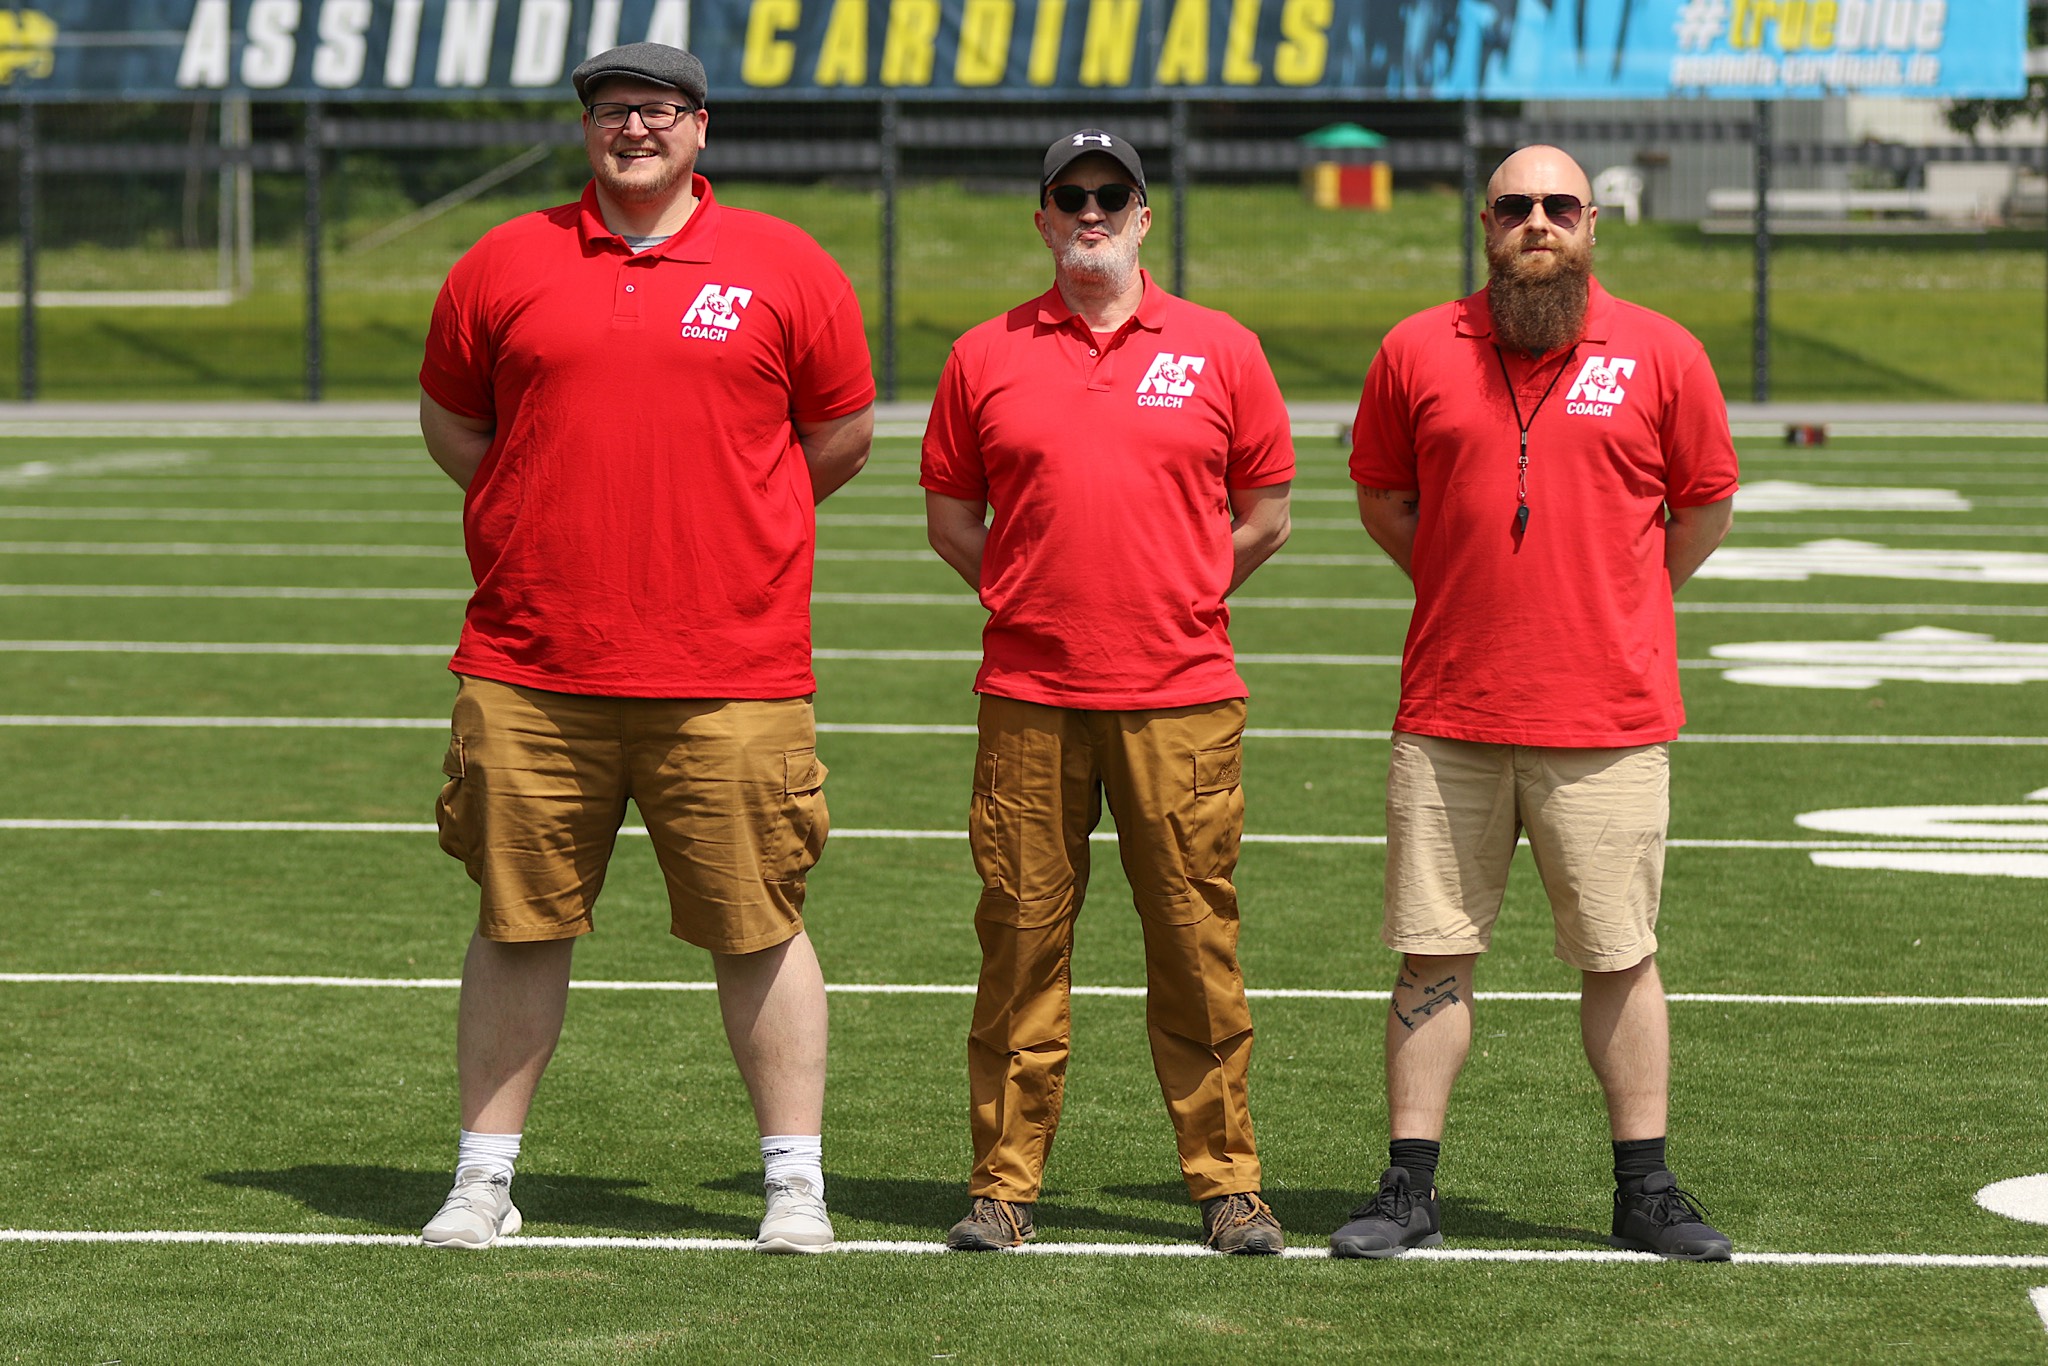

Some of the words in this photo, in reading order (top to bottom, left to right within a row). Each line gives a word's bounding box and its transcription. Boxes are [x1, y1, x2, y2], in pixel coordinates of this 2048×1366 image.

[1673, 0, 1946, 50] #trueblue
[175, 0, 690, 88] ASSINDIA
[740, 0, 1334, 87] CARDINALS
[681, 325, 728, 342] COACH
[1137, 394, 1183, 409] COACH
[1566, 401, 1613, 417] COACH
